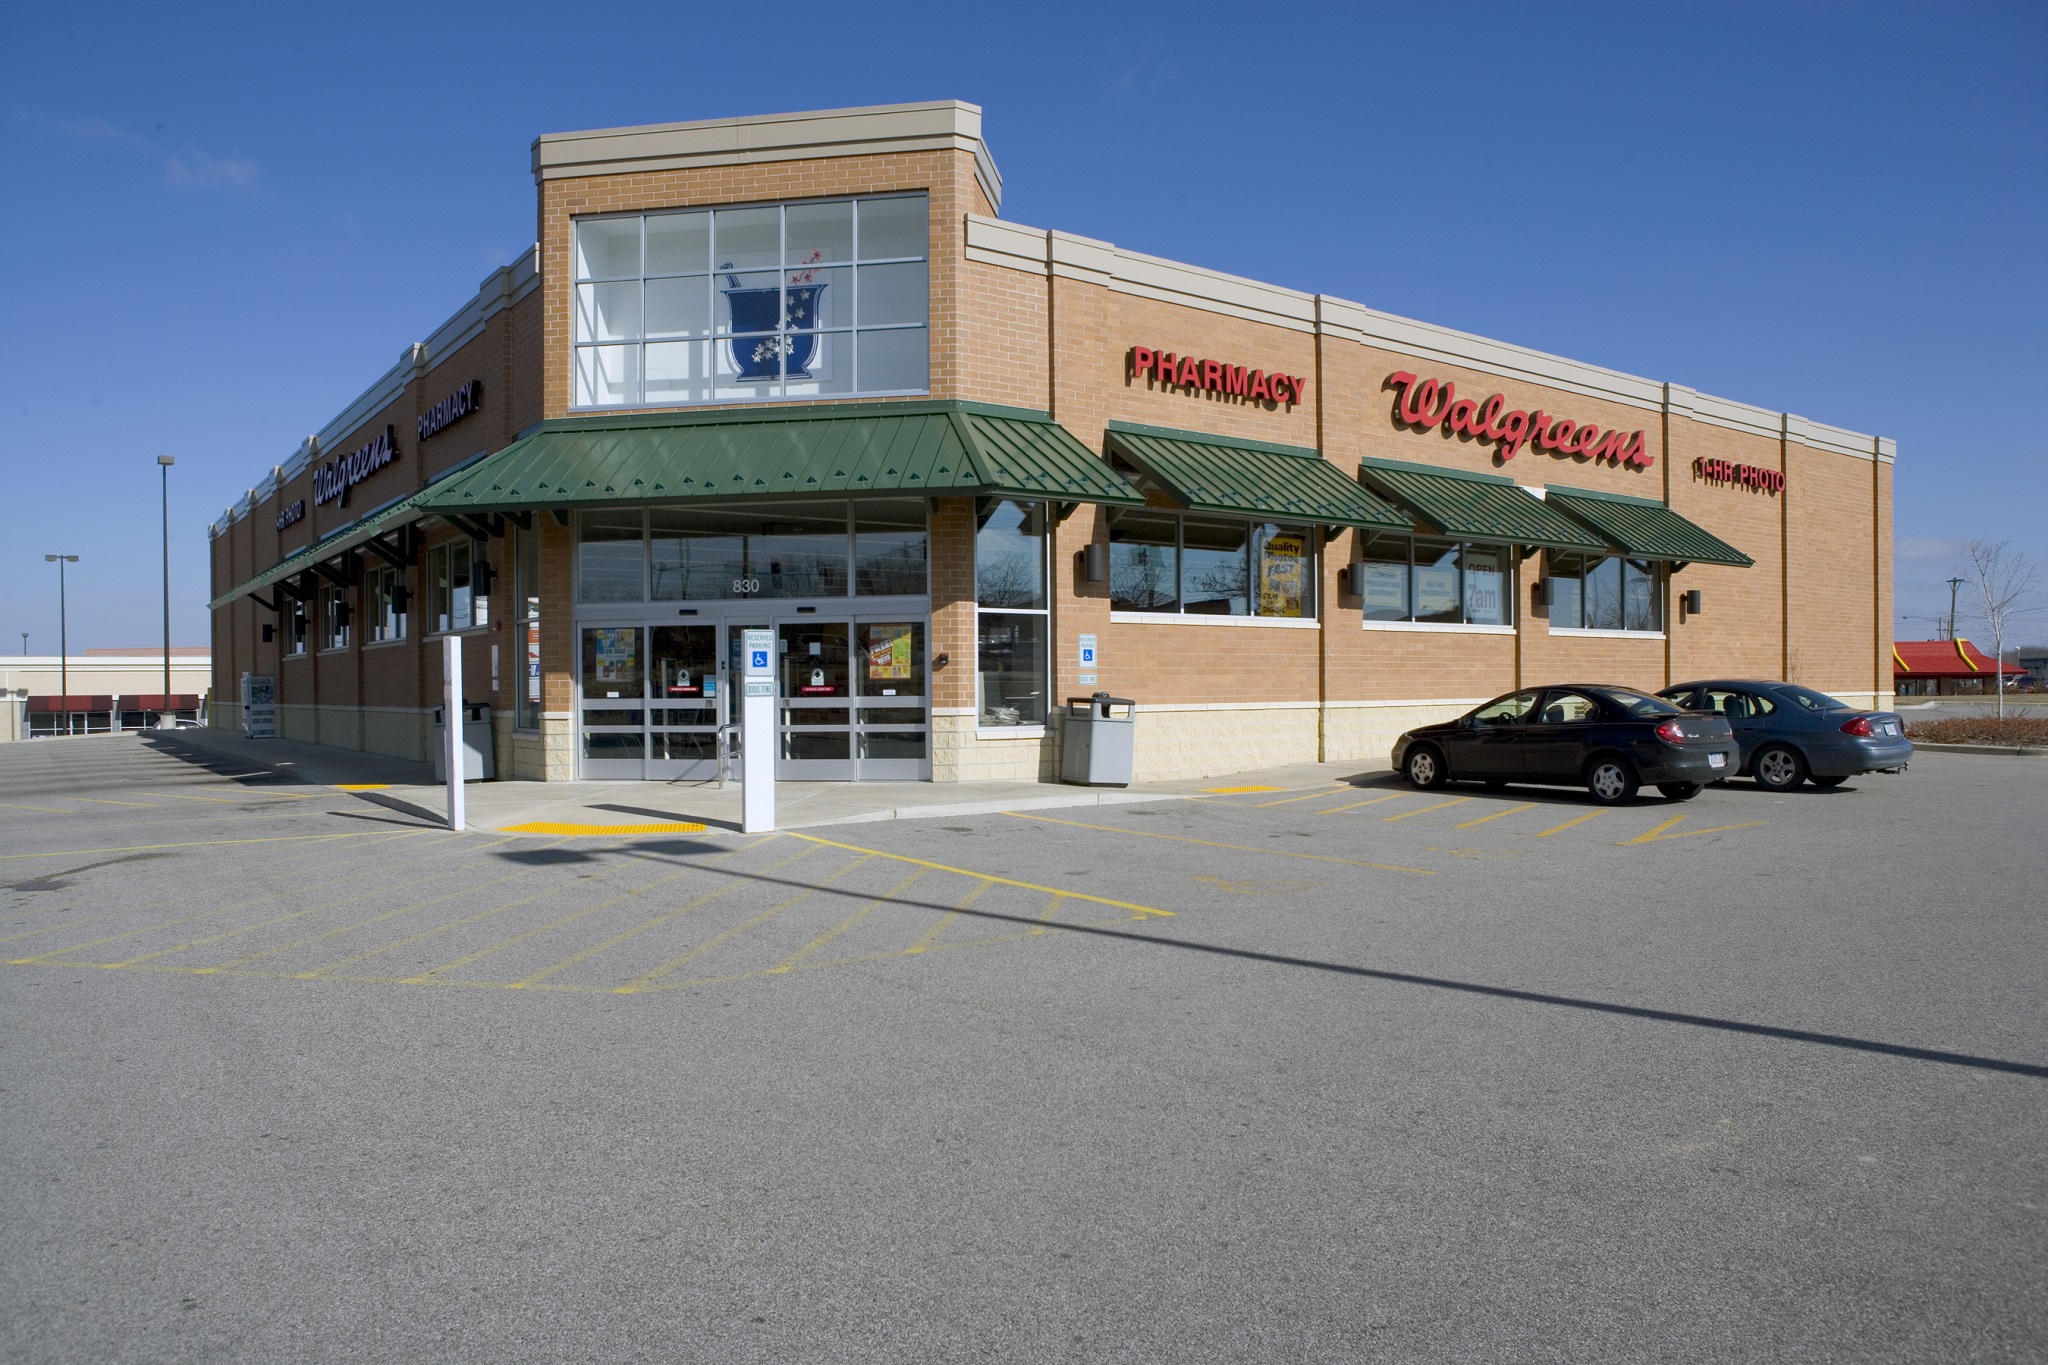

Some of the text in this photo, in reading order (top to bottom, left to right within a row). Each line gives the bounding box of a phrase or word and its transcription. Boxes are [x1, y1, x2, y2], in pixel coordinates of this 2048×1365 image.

[1135, 345, 1307, 406] PHARMACY
[417, 380, 477, 442] PHARMACY
[1391, 370, 1655, 468] Walgreens
[313, 424, 394, 508] Walgreens
[1698, 456, 1786, 493] 1-HR PHOTO
[1264, 541, 1300, 554] Quality
[1468, 563, 1495, 576] OPEN
[733, 579, 760, 593] 830
[1467, 583, 1496, 609] 7am
[748, 685, 773, 694] $100 FINE
